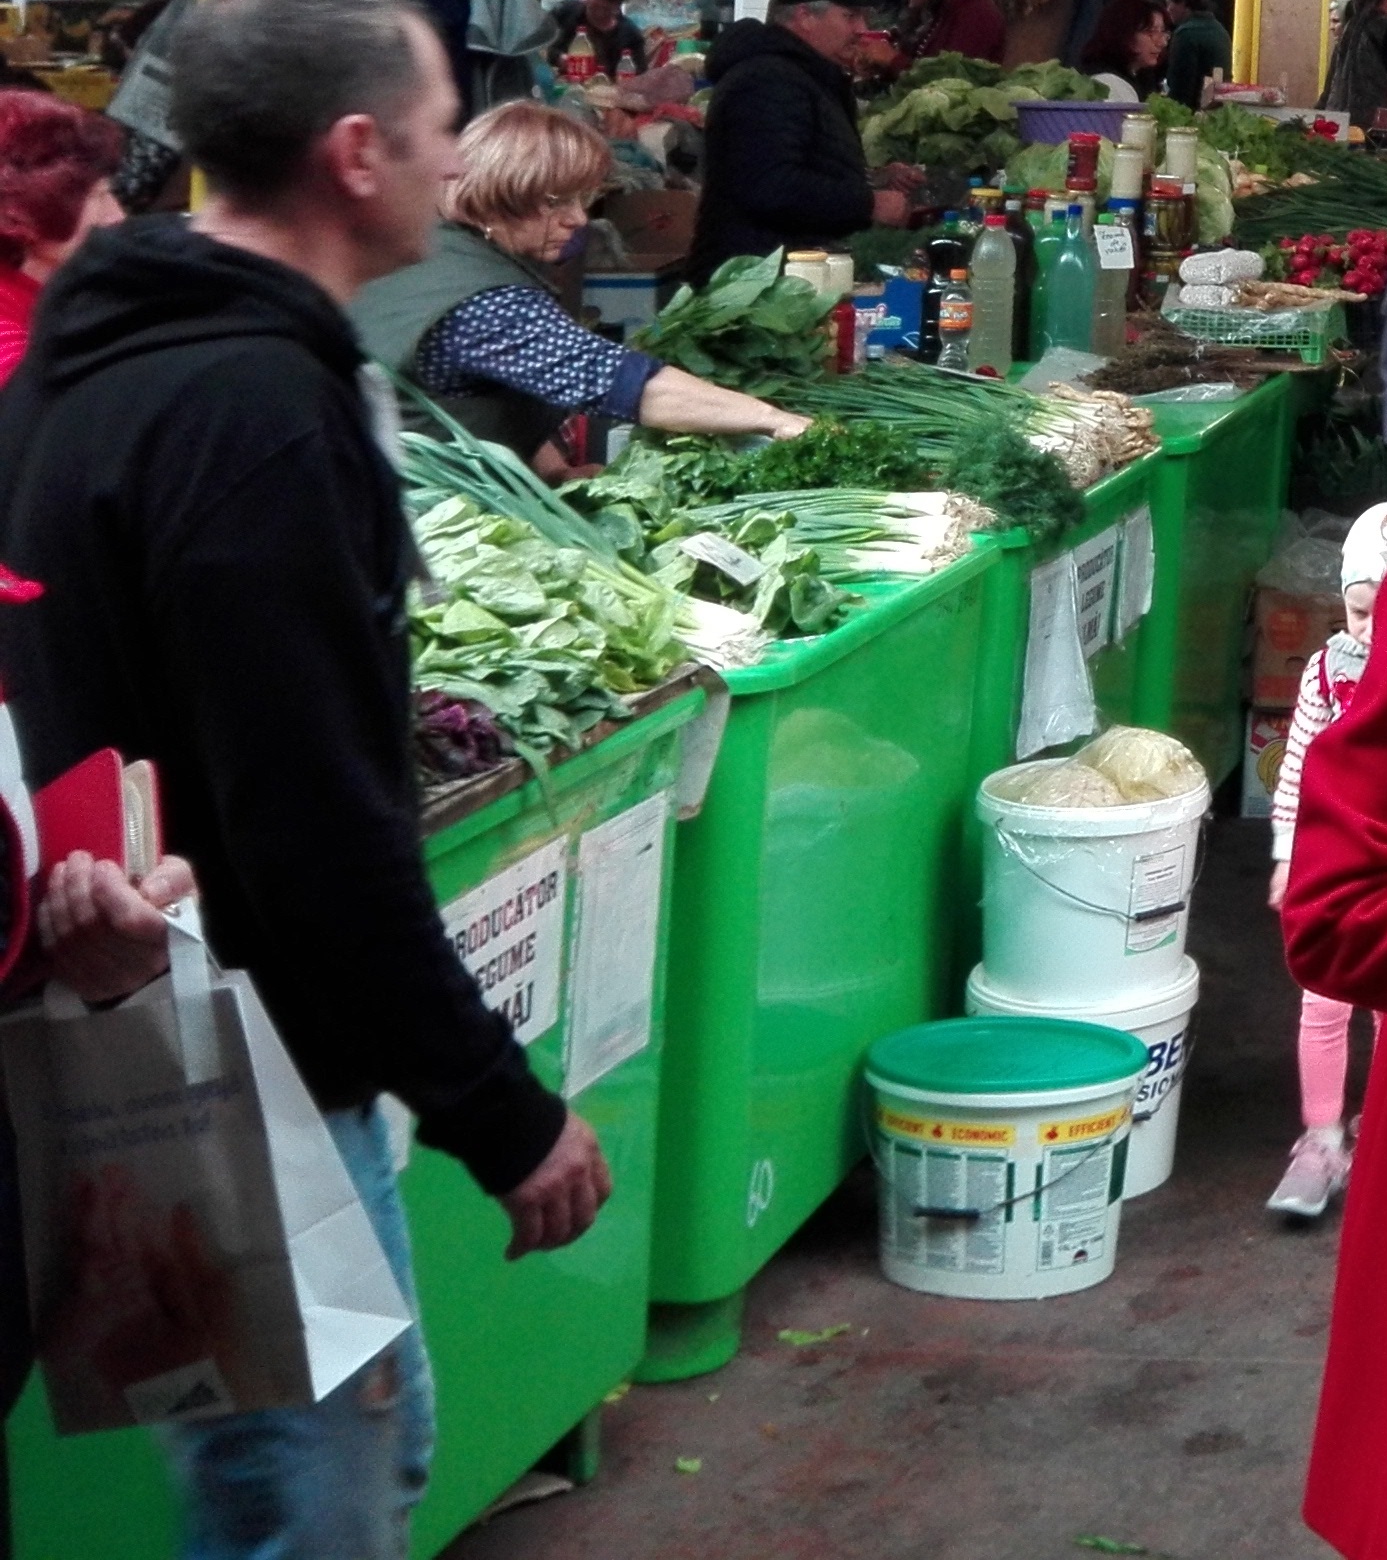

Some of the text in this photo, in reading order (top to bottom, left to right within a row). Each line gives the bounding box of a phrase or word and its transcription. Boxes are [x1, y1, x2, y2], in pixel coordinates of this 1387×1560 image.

[456, 870, 559, 961] RODUCĂTOR
[475, 930, 537, 991] EGUME
[950, 1127, 1009, 1143] ECONOMIC
